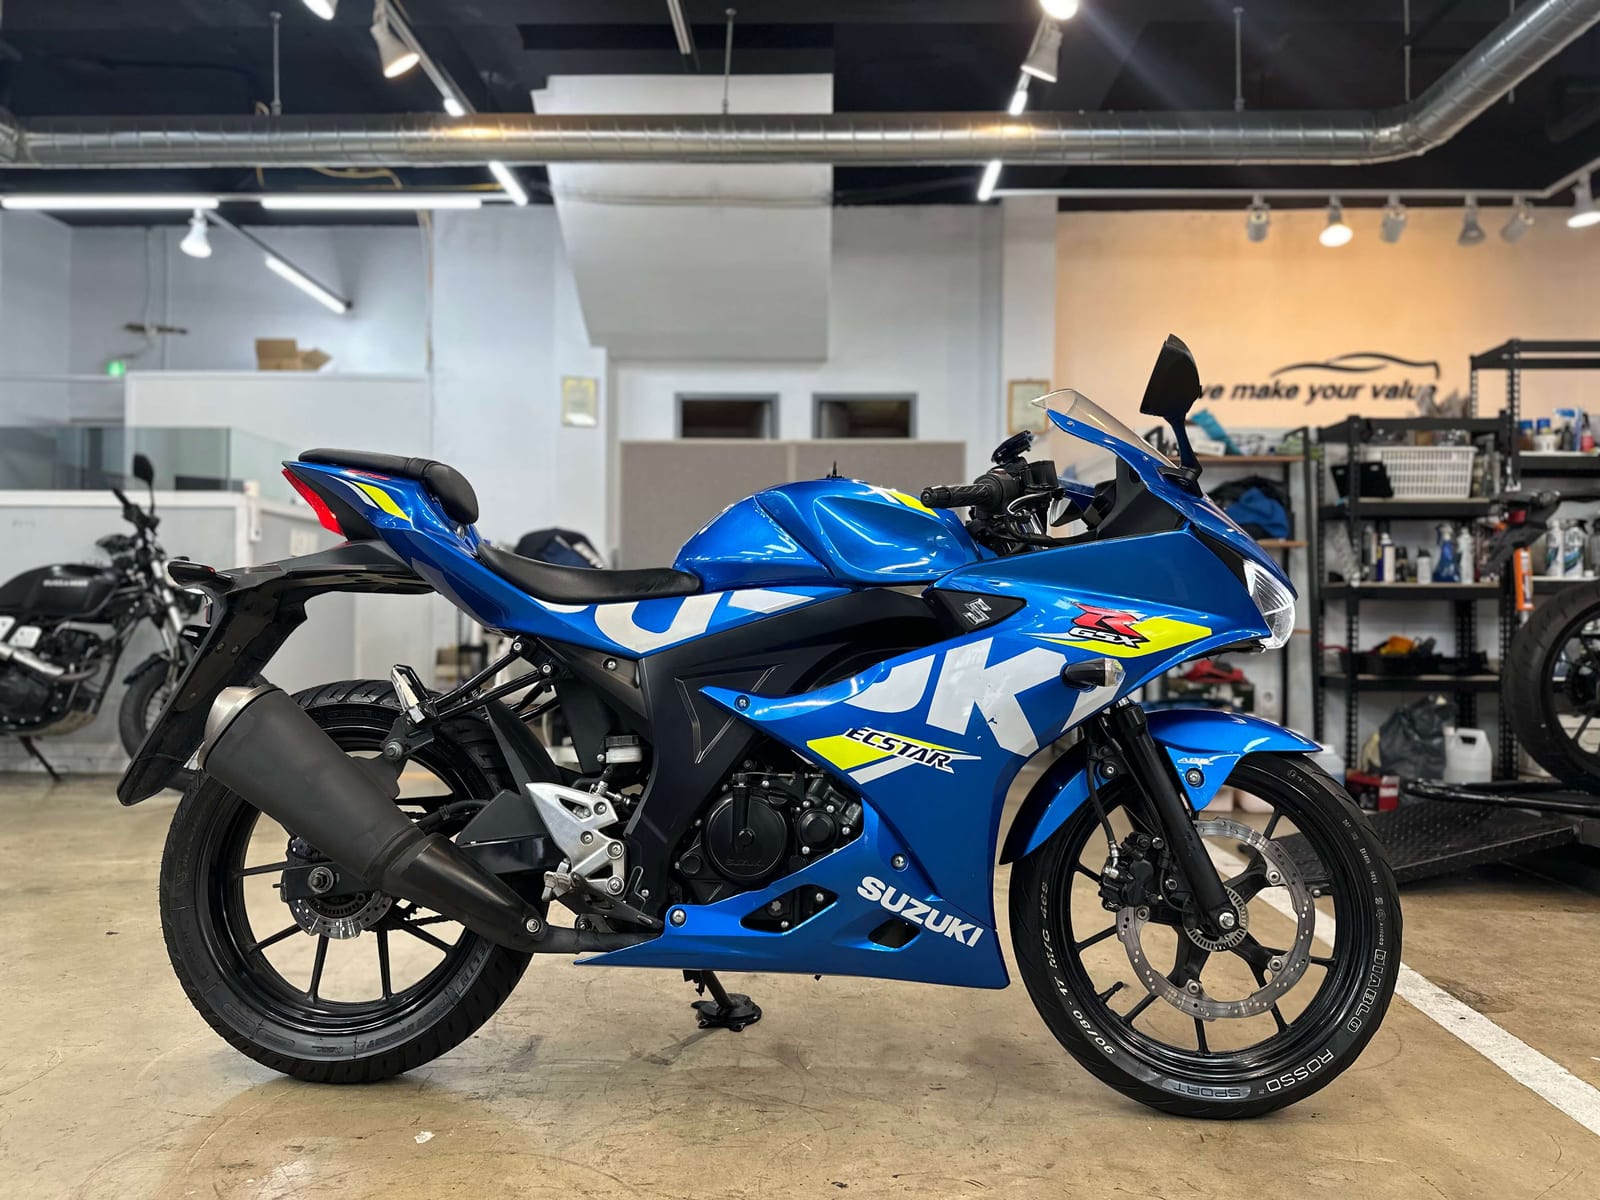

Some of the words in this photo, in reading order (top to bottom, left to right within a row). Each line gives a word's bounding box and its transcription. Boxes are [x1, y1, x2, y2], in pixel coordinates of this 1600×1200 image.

[1231, 379, 1299, 400] make
[1304, 384, 1364, 405] your
[1070, 627, 1140, 648] GSX
[844, 726, 955, 772] ECSTAR
[857, 875, 984, 949] SUZUKI
[1053, 976, 1069, 996] 17
[1346, 949, 1388, 1034] DIABLO
[1072, 1009, 1116, 1055] 90/80
[1173, 1083, 1241, 1098] SPORT
[1265, 1048, 1336, 1093] ROSSO
